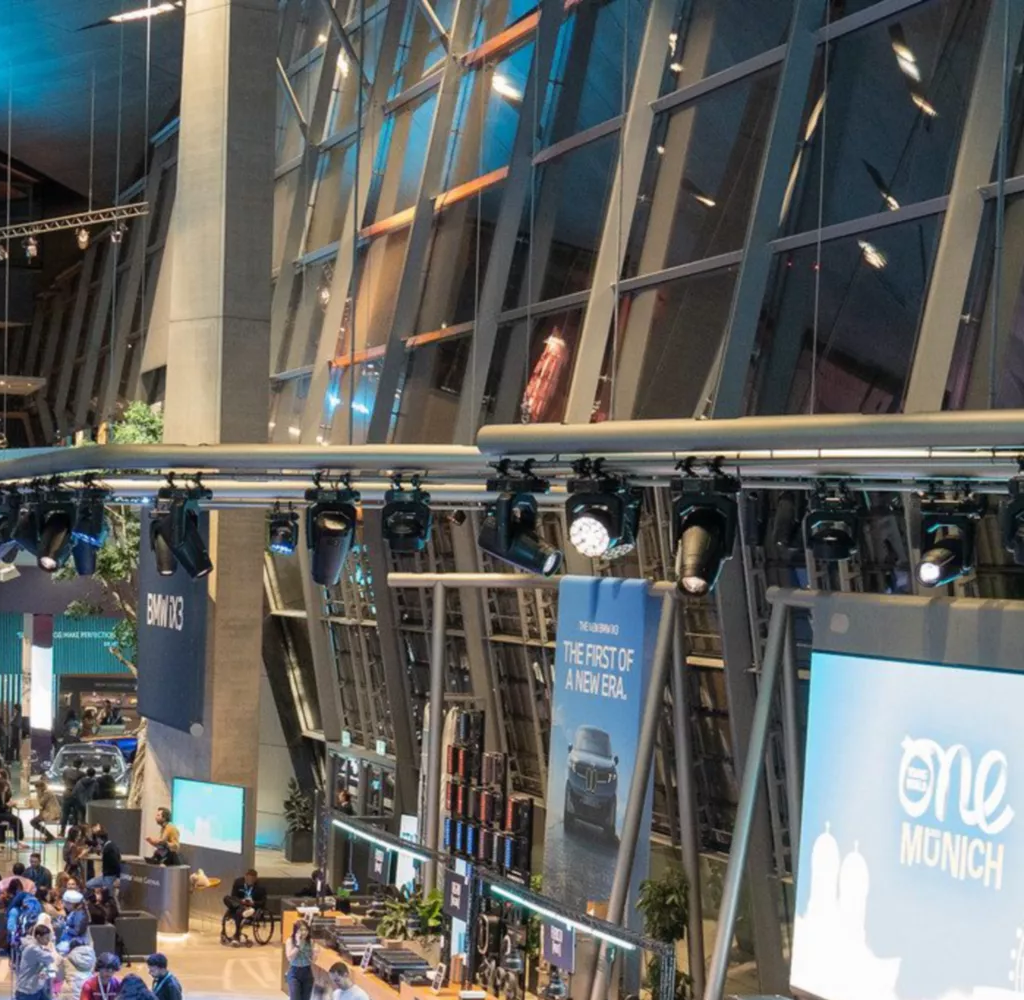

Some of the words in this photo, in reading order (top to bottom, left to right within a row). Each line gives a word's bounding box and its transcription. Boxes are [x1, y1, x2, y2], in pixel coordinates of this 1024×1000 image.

[563, 640, 584, 665] THE
[586, 643, 617, 669] FIRST
[618, 647, 635, 672] OF
[564, 667, 574, 691] A
[575, 669, 600, 695] NEW
[601, 673, 628, 700] ERA.
[900, 821, 1005, 891] MUNICH
